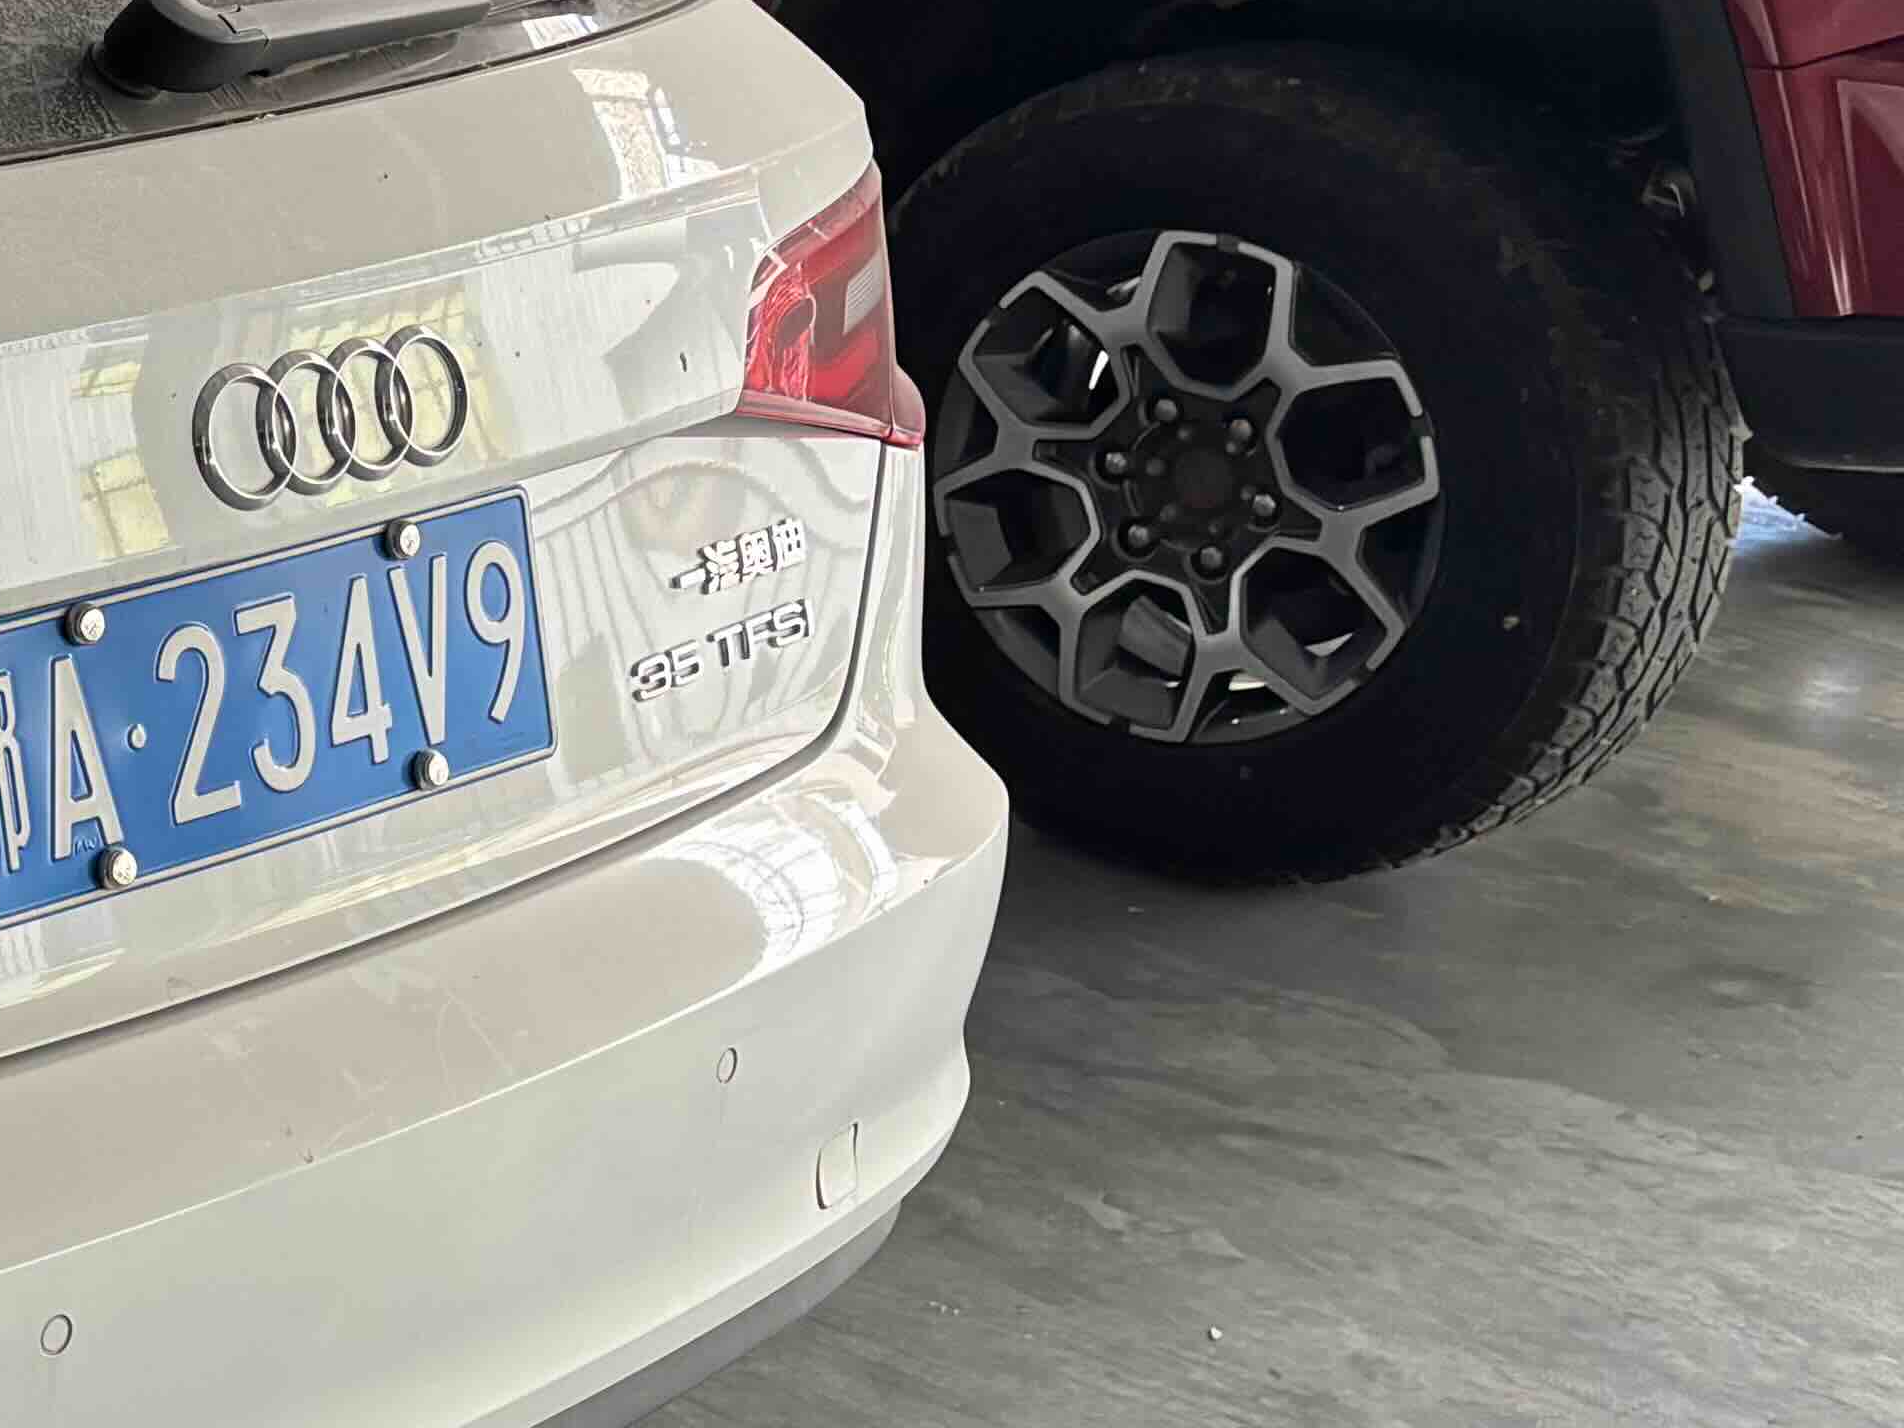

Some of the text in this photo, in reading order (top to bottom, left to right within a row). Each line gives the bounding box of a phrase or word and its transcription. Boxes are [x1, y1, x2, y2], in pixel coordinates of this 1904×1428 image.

[670, 516, 807, 595] 一汽奥迪
[628, 597, 816, 702] 35 TFSI
